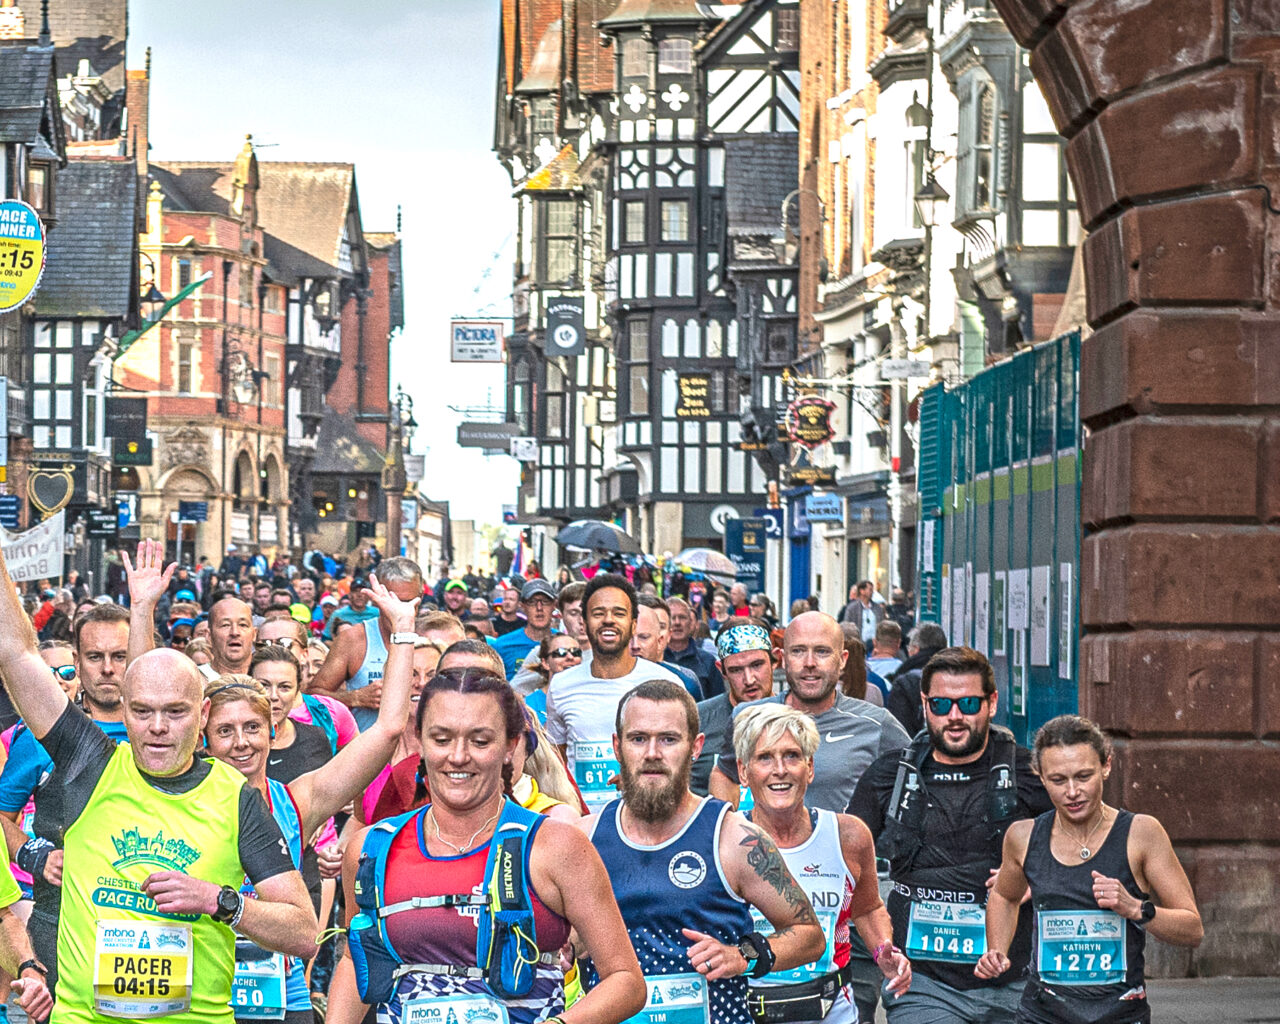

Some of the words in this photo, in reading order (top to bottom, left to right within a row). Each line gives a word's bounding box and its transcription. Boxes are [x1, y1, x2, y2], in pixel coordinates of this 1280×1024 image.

[4, 269, 23, 277] 09:43
[585, 769, 615, 784] 612
[98, 890, 134, 907] PACE
[917, 887, 975, 903] SUNDRIED
[1047, 919, 1073, 927] mbna
[104, 928, 135, 938] mbna
[933, 927, 960, 936] DANIEL
[921, 935, 974, 954] 1048
[1063, 943, 1101, 951] KATHRYN
[114, 957, 172, 976] PACER
[1054, 953, 1112, 971] 1278
[114, 976, 170, 996] 04:15
[233, 978, 257, 987] ACHEL
[411, 1008, 440, 1018] mbna
[649, 1013, 667, 1023] TIM
